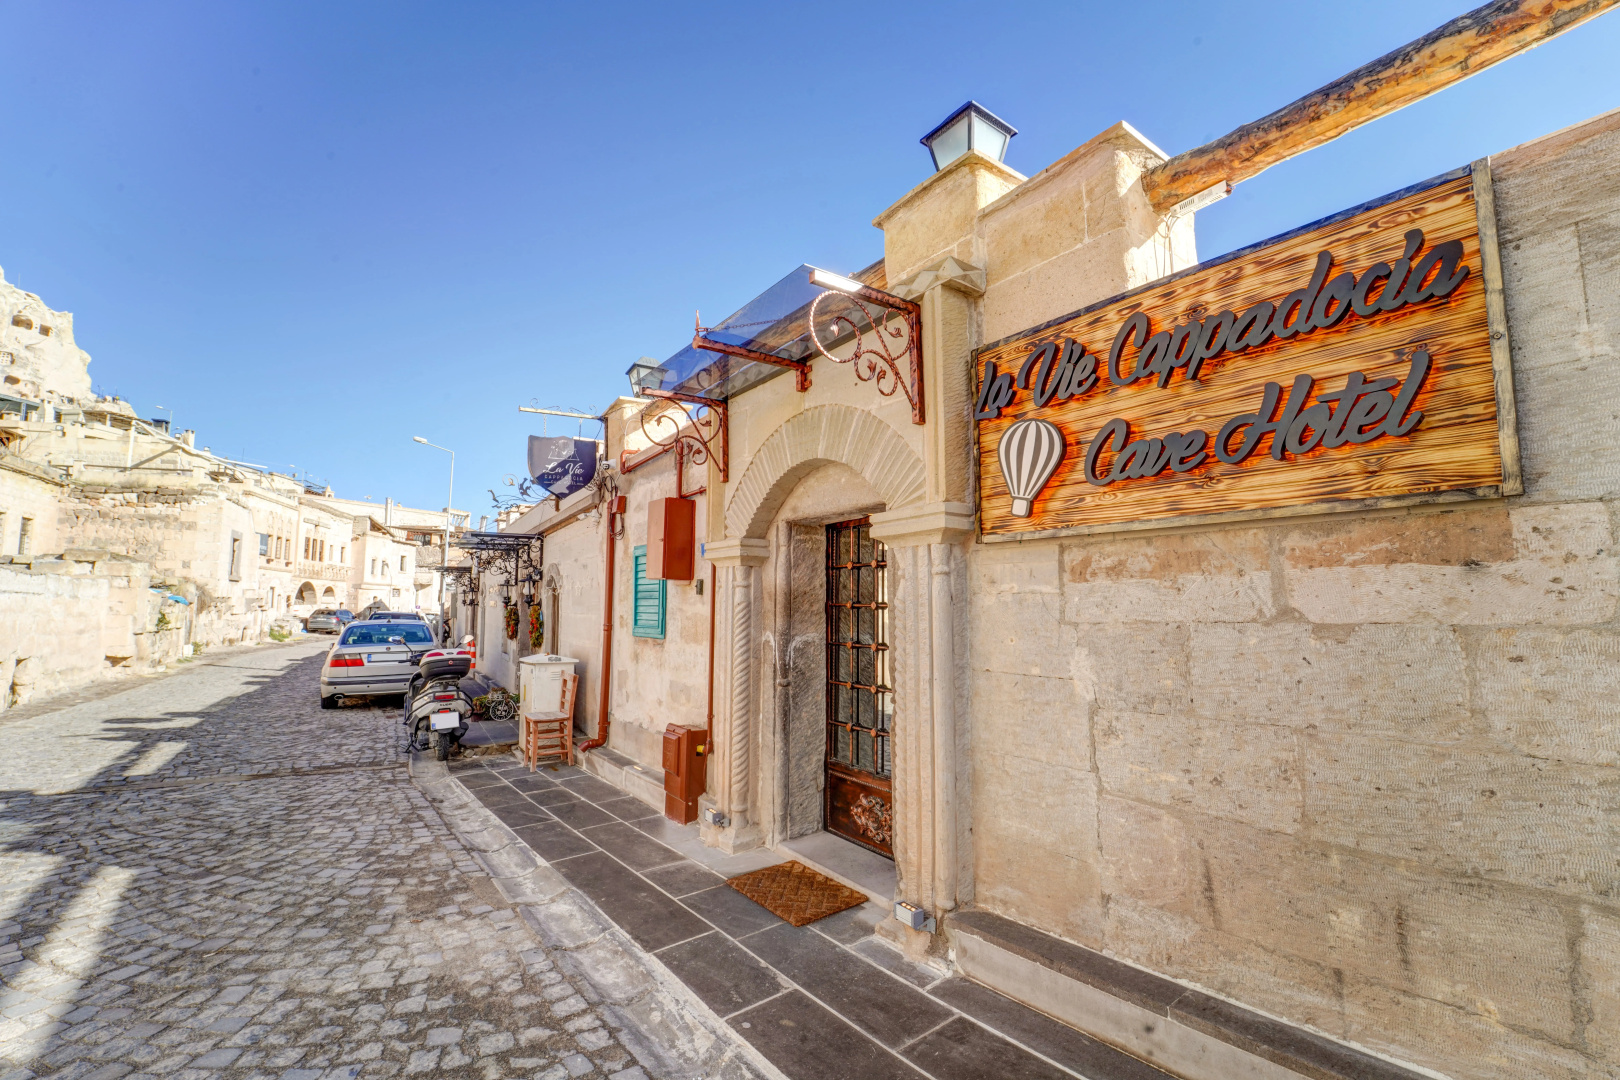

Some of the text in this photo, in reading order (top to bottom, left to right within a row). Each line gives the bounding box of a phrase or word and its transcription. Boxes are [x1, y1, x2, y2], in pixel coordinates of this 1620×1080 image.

[974, 228, 1470, 421] La Vie Cappadocia
[543, 462, 584, 474] La Vie
[1083, 350, 1431, 486] Cave Hotel
